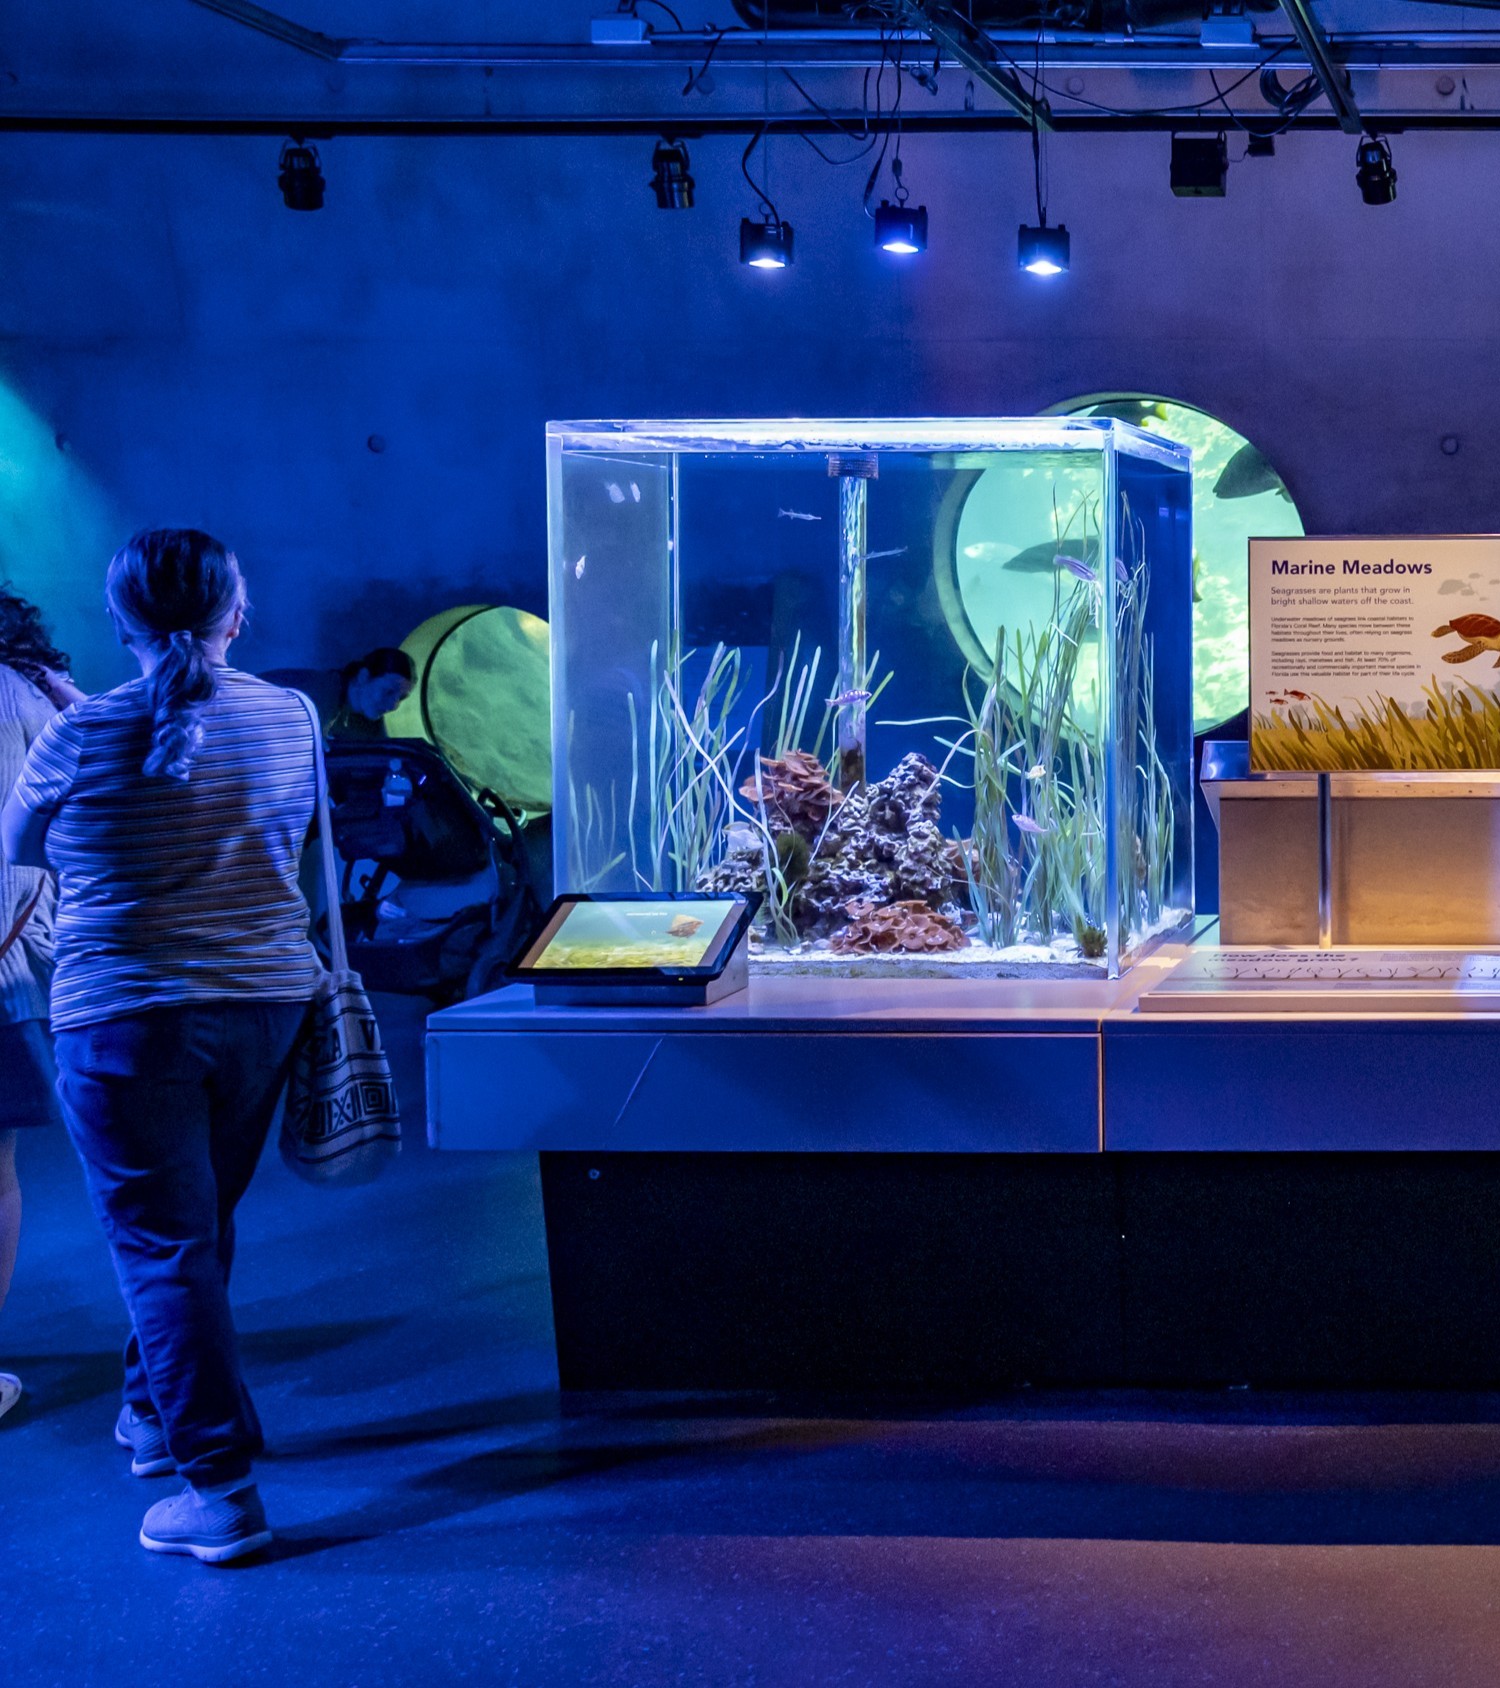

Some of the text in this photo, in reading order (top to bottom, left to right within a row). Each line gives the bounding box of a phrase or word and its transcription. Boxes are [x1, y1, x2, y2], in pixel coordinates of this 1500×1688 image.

[1272, 559, 1432, 575] Marine Meadows
[1271, 586, 1316, 596] Seagrasses
[1334, 586, 1358, 596] plants
[1271, 597, 1296, 606] bright
